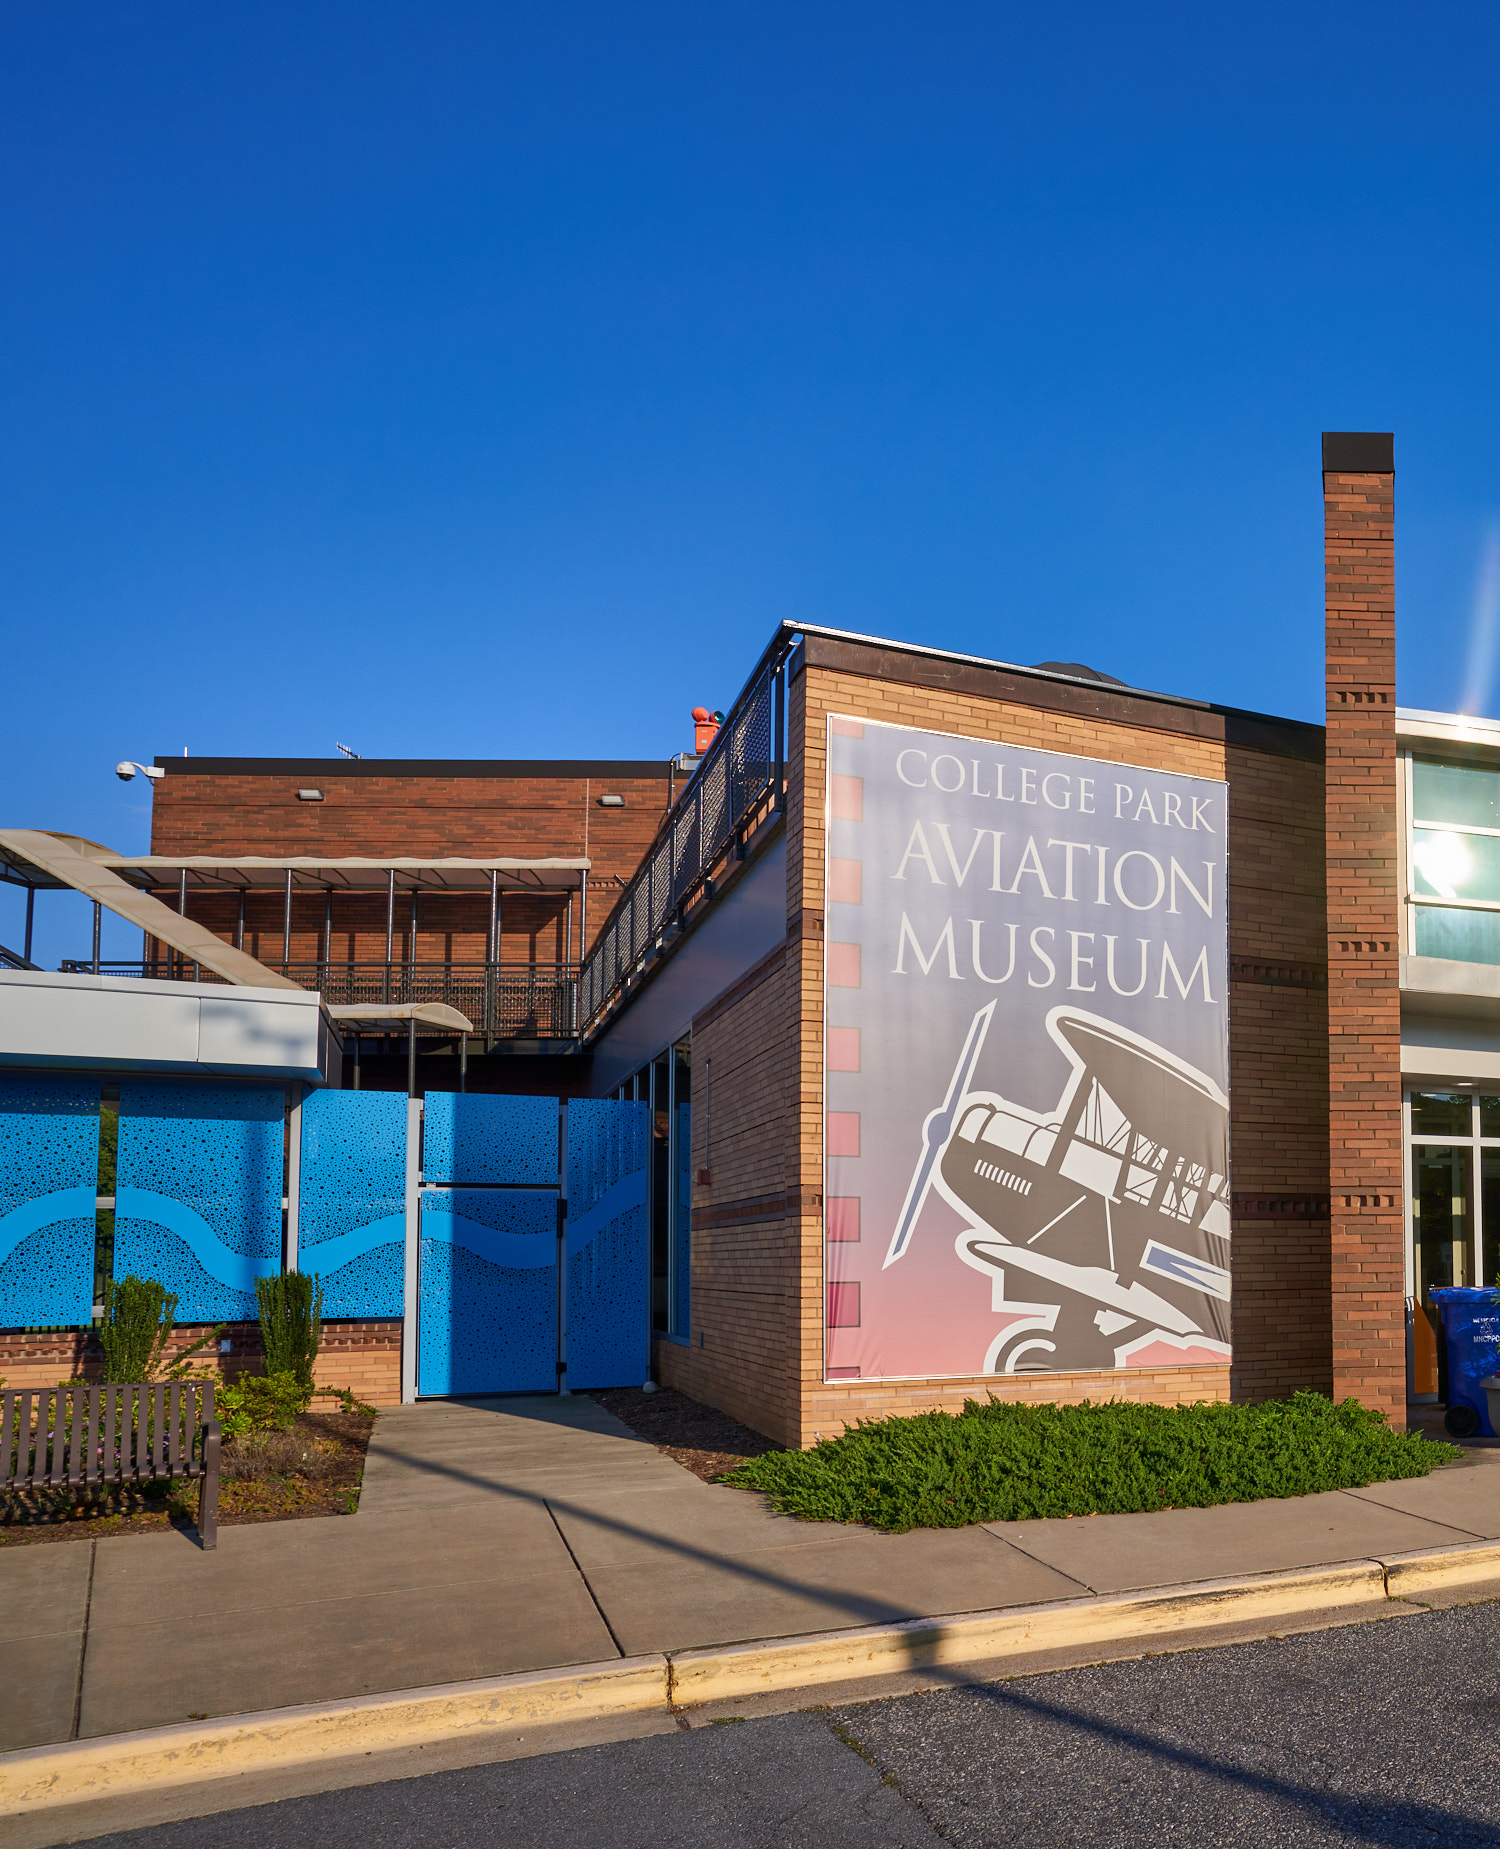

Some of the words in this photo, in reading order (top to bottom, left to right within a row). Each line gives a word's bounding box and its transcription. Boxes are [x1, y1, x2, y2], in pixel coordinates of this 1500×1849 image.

[896, 748, 1096, 814] COLLEGE
[1114, 783, 1216, 834] PARK
[890, 819, 1217, 919] AVIATION
[891, 910, 1218, 1004] MUSEUM
[1473, 1334, 1500, 1343] MNCPPC
